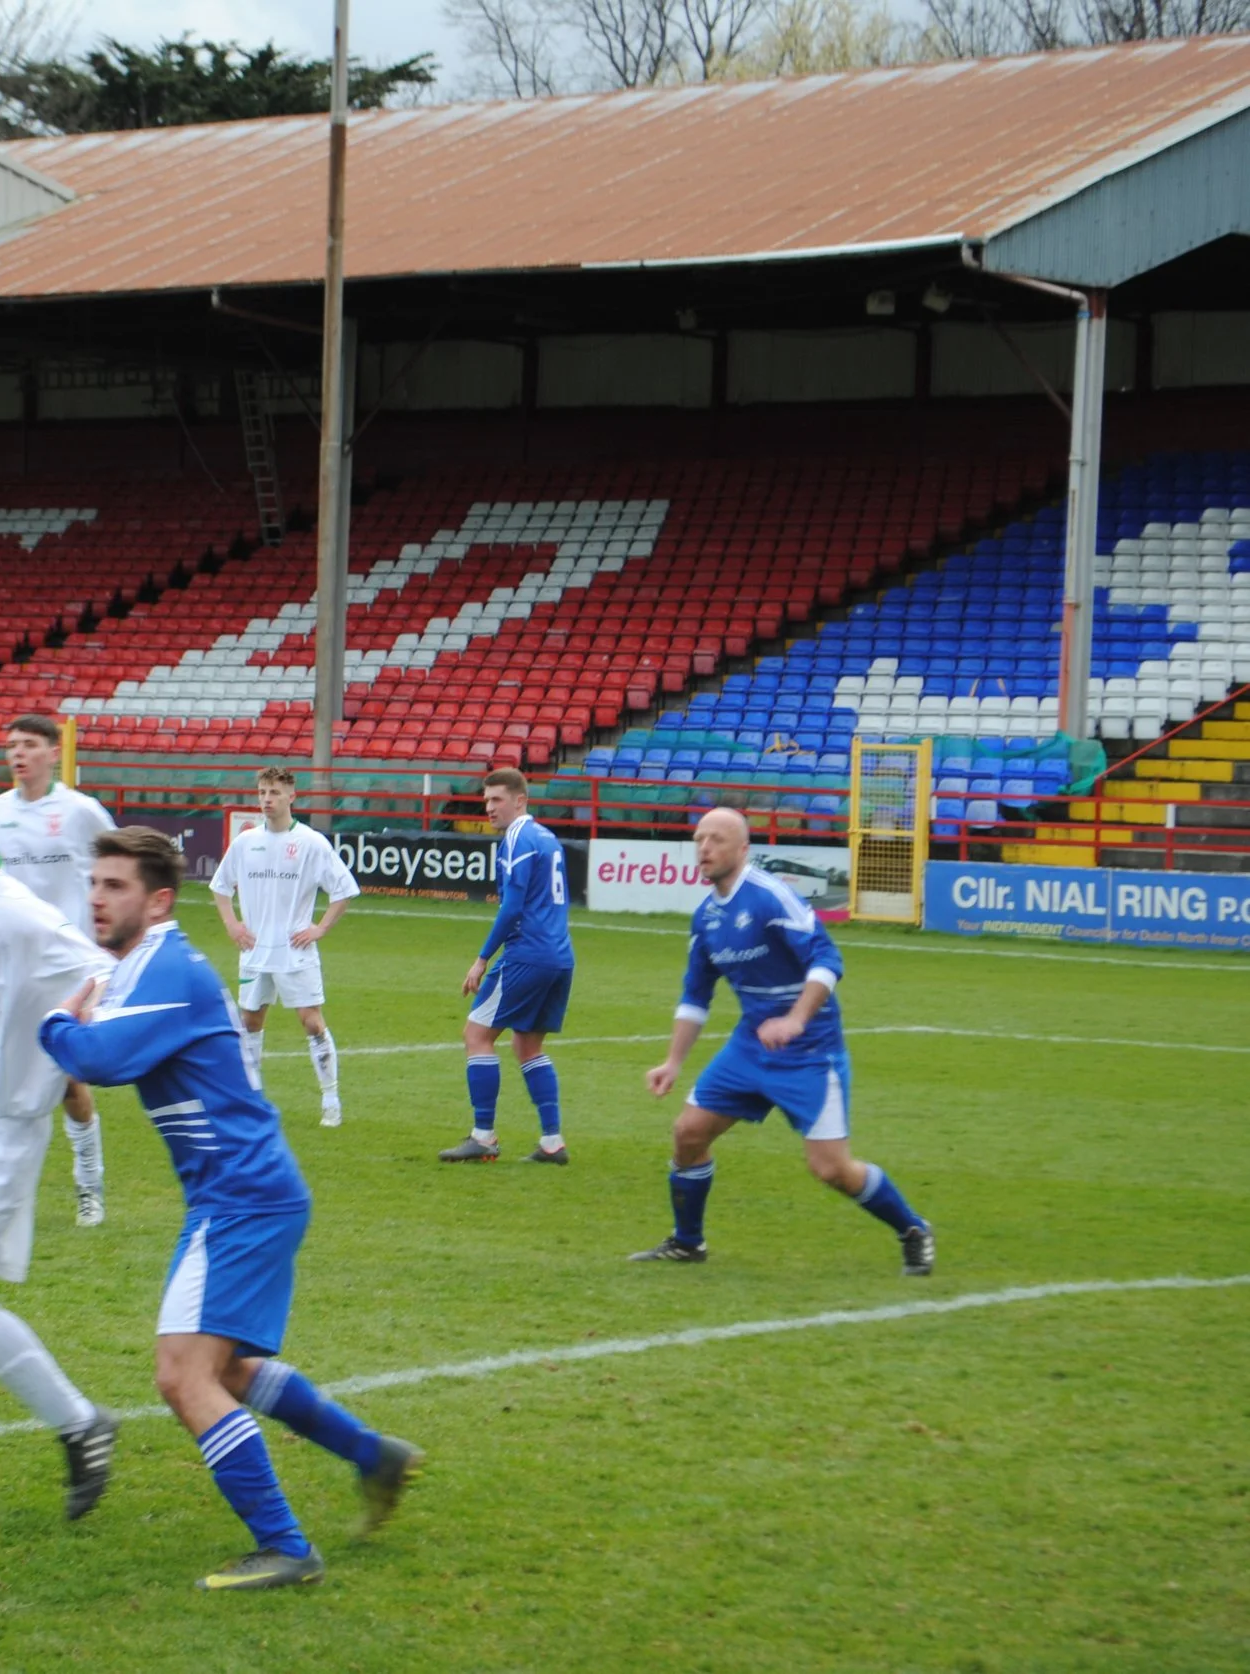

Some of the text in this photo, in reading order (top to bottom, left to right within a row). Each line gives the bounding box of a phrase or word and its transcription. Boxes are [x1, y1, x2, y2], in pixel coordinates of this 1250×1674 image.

[334, 833, 497, 886] bbeyseal
[552, 850, 565, 905] 6
[952, 876, 1015, 910] Cllr.
[1026, 880, 1106, 915] NIAL
[1117, 885, 1208, 921] RING
[957, 919, 982, 931] Your
[982, 919, 1065, 936] INDEPENDENT
[1065, 924, 1120, 940] Councillor
[1122, 929, 1138, 940] for
[1140, 930, 1174, 942] Dublin
[1177, 931, 1209, 944] North
[1211, 933, 1239, 945] Inner
